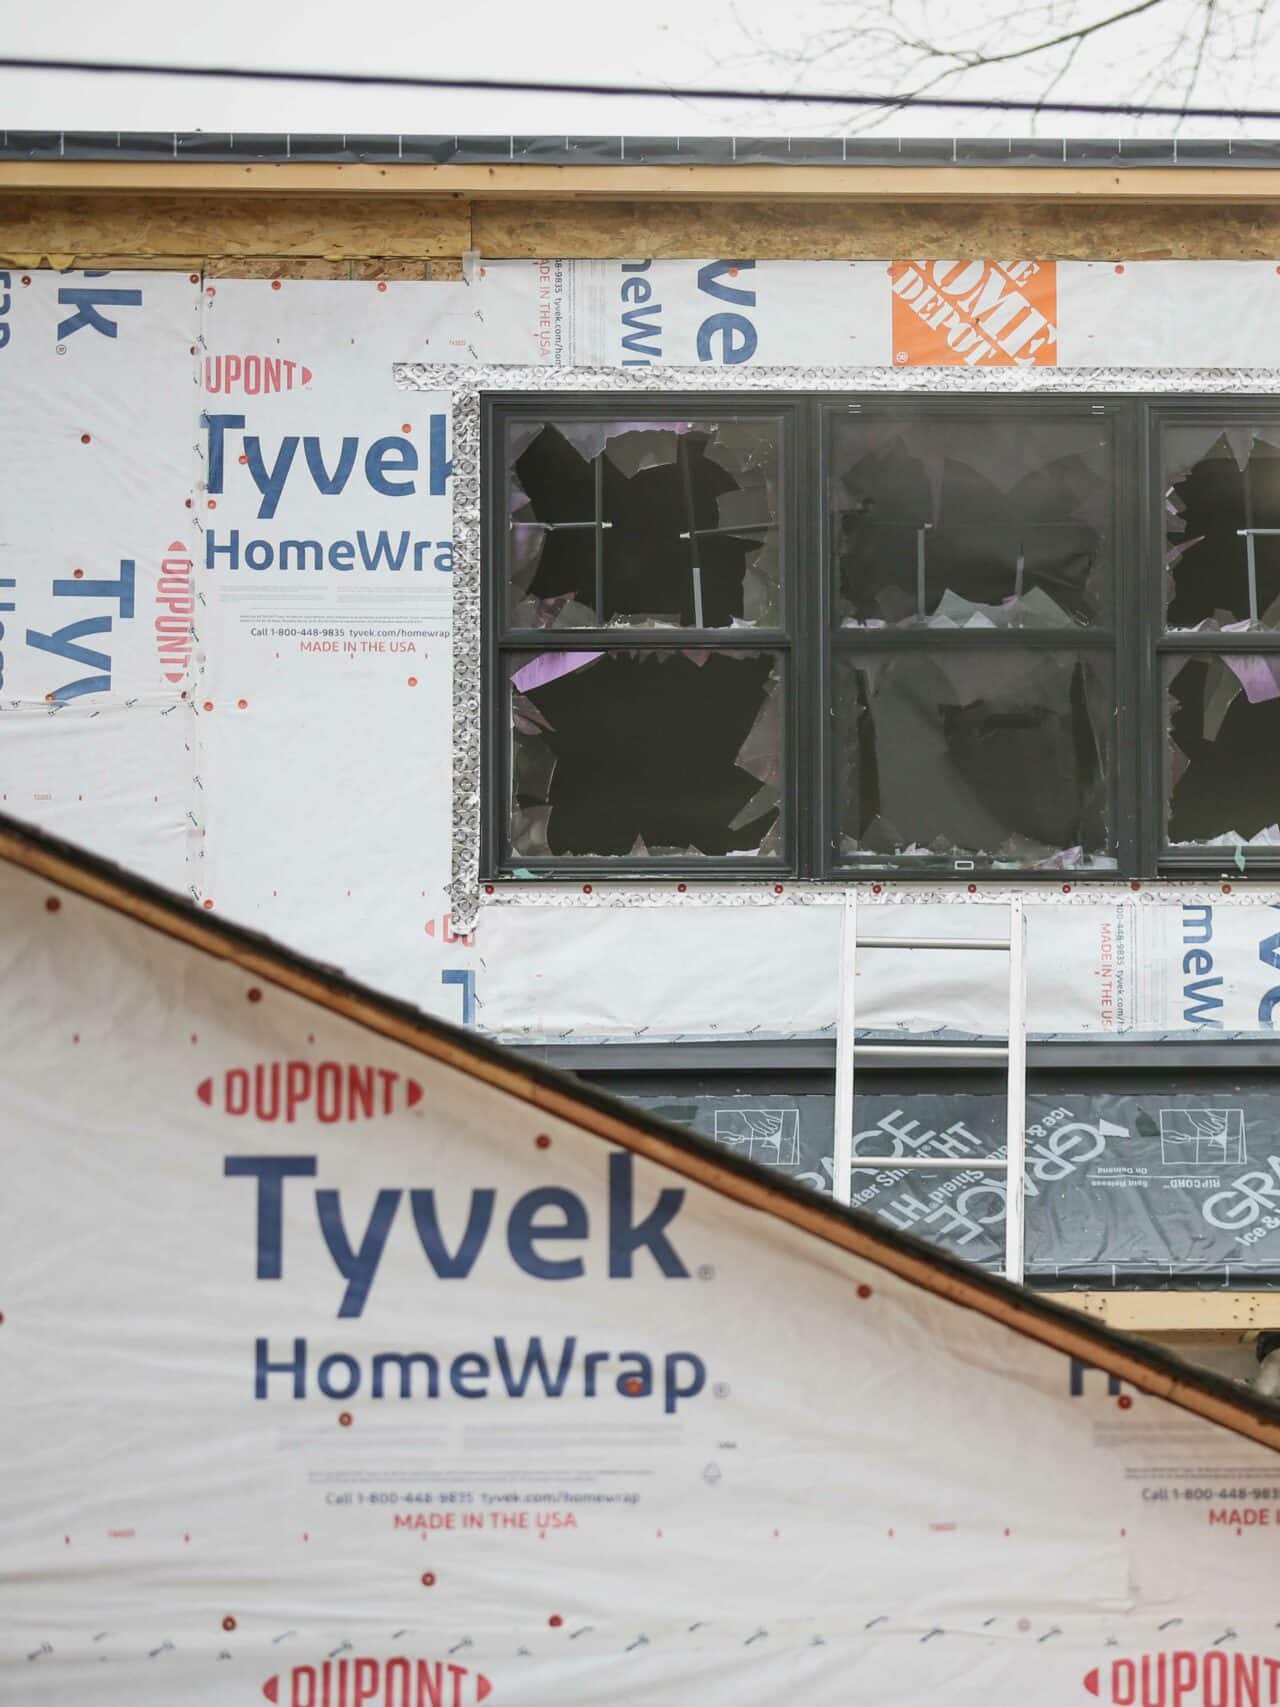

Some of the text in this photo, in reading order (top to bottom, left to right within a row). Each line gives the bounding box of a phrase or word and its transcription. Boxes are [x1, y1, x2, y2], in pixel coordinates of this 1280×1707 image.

[539, 259, 551, 282] ADE
[892, 266, 997, 365] DEPOT
[914, 260, 1057, 366] OME
[205, 355, 297, 394] UPONT
[206, 530, 453, 571] HomeWra
[155, 559, 195, 668] DUPONT
[250, 627, 450, 638] Call 1-800-448-9835 tyvek.com/homewrap
[300, 641, 417, 653] MADE IN THE USA
[1100, 923, 1112, 960] MADE
[1101, 963, 1112, 978] IN
[1101, 981, 1112, 1006] THE
[225, 1061, 400, 1124] DUPONT
[1044, 1107, 1074, 1126] Ice
[850, 1184, 881, 1208] ater
[928, 1121, 983, 1159] HT
[924, 1122, 1106, 1245] GRACE
[928, 1169, 985, 1204] Shield
[224, 1152, 691, 1318] Tyvek
[1235, 1225, 1267, 1247] Ice
[255, 1336, 707, 1414] HomeWrap
[325, 1491, 354, 1506] Call
[480, 1491, 641, 1507] tyvek.com/homewrap
[1141, 1488, 1169, 1501] Call
[394, 1511, 578, 1530] MADE IN THE USA
[1208, 1508, 1270, 1526] MADE
[291, 1656, 468, 1707] DUPONT
